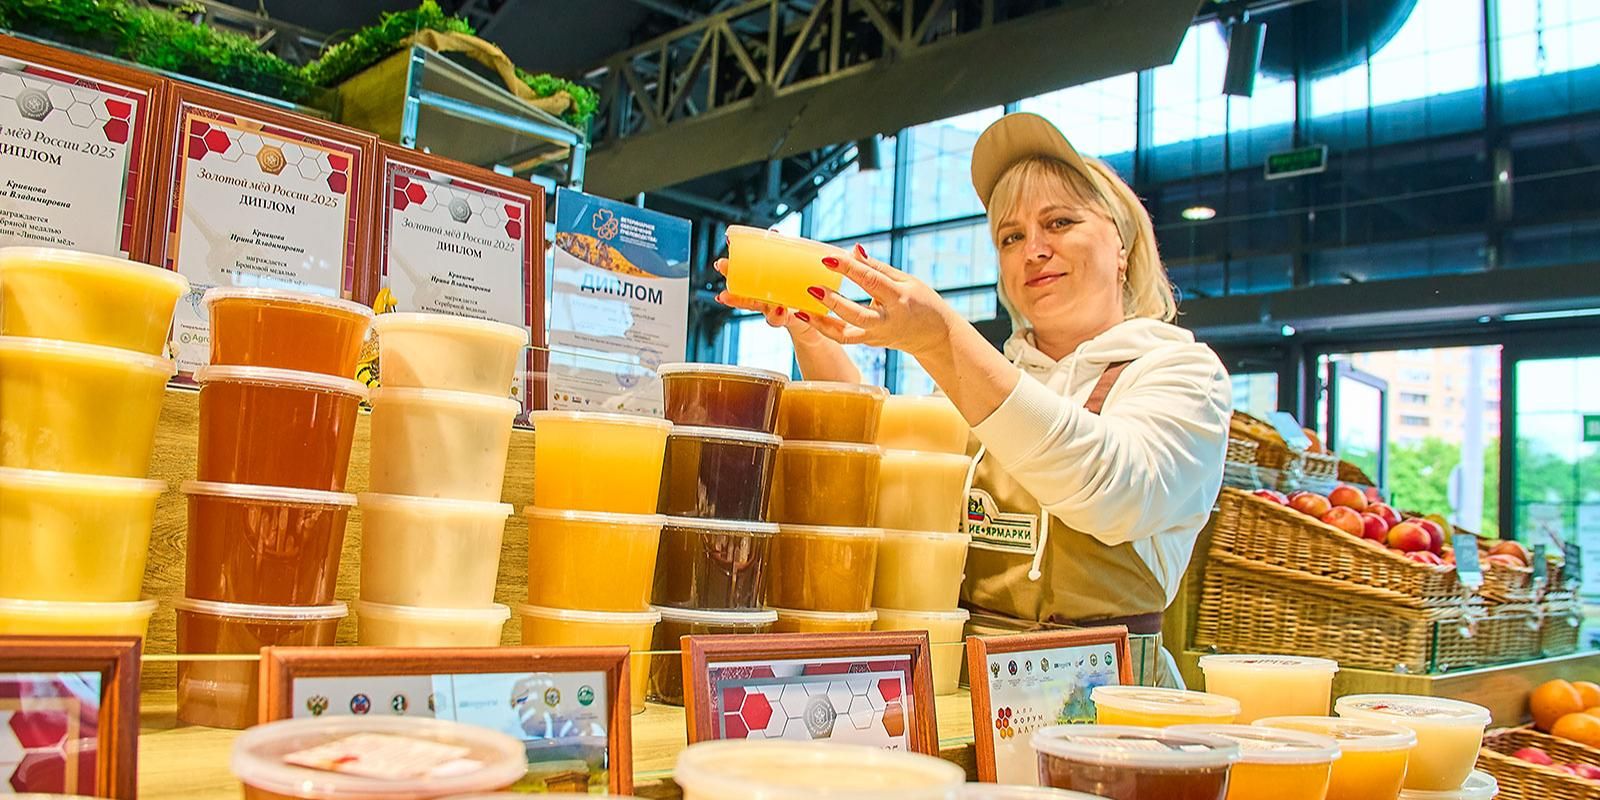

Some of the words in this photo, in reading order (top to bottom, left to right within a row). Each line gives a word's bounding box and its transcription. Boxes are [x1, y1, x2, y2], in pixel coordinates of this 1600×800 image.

[5, 127, 32, 140] мёд
[34, 131, 80, 151] России
[82, 142, 116, 159] 2025
[6, 180, 47, 194] Кривцова
[197, 167, 248, 188] Золотой
[249, 181, 271, 193] мёд
[272, 184, 310, 201] России
[310, 193, 339, 208] 2025
[9, 190, 71, 208] Владимировна
[239, 194, 296, 215] ДИПЛОМ
[230, 233, 254, 244] Ирина
[255, 238, 305, 254] Владимировна
[401, 217, 443, 236] Золотой
[443, 228, 461, 240] мёд
[462, 231, 493, 247] России
[493, 239, 515, 253] 2025
[436, 240, 482, 259] ДИПЛОМ
[580, 272, 663, 305] ДИПЛОМ
[968, 524, 980, 534] ИЕ
[986, 526, 1031, 540] ЯРМАРКИ
